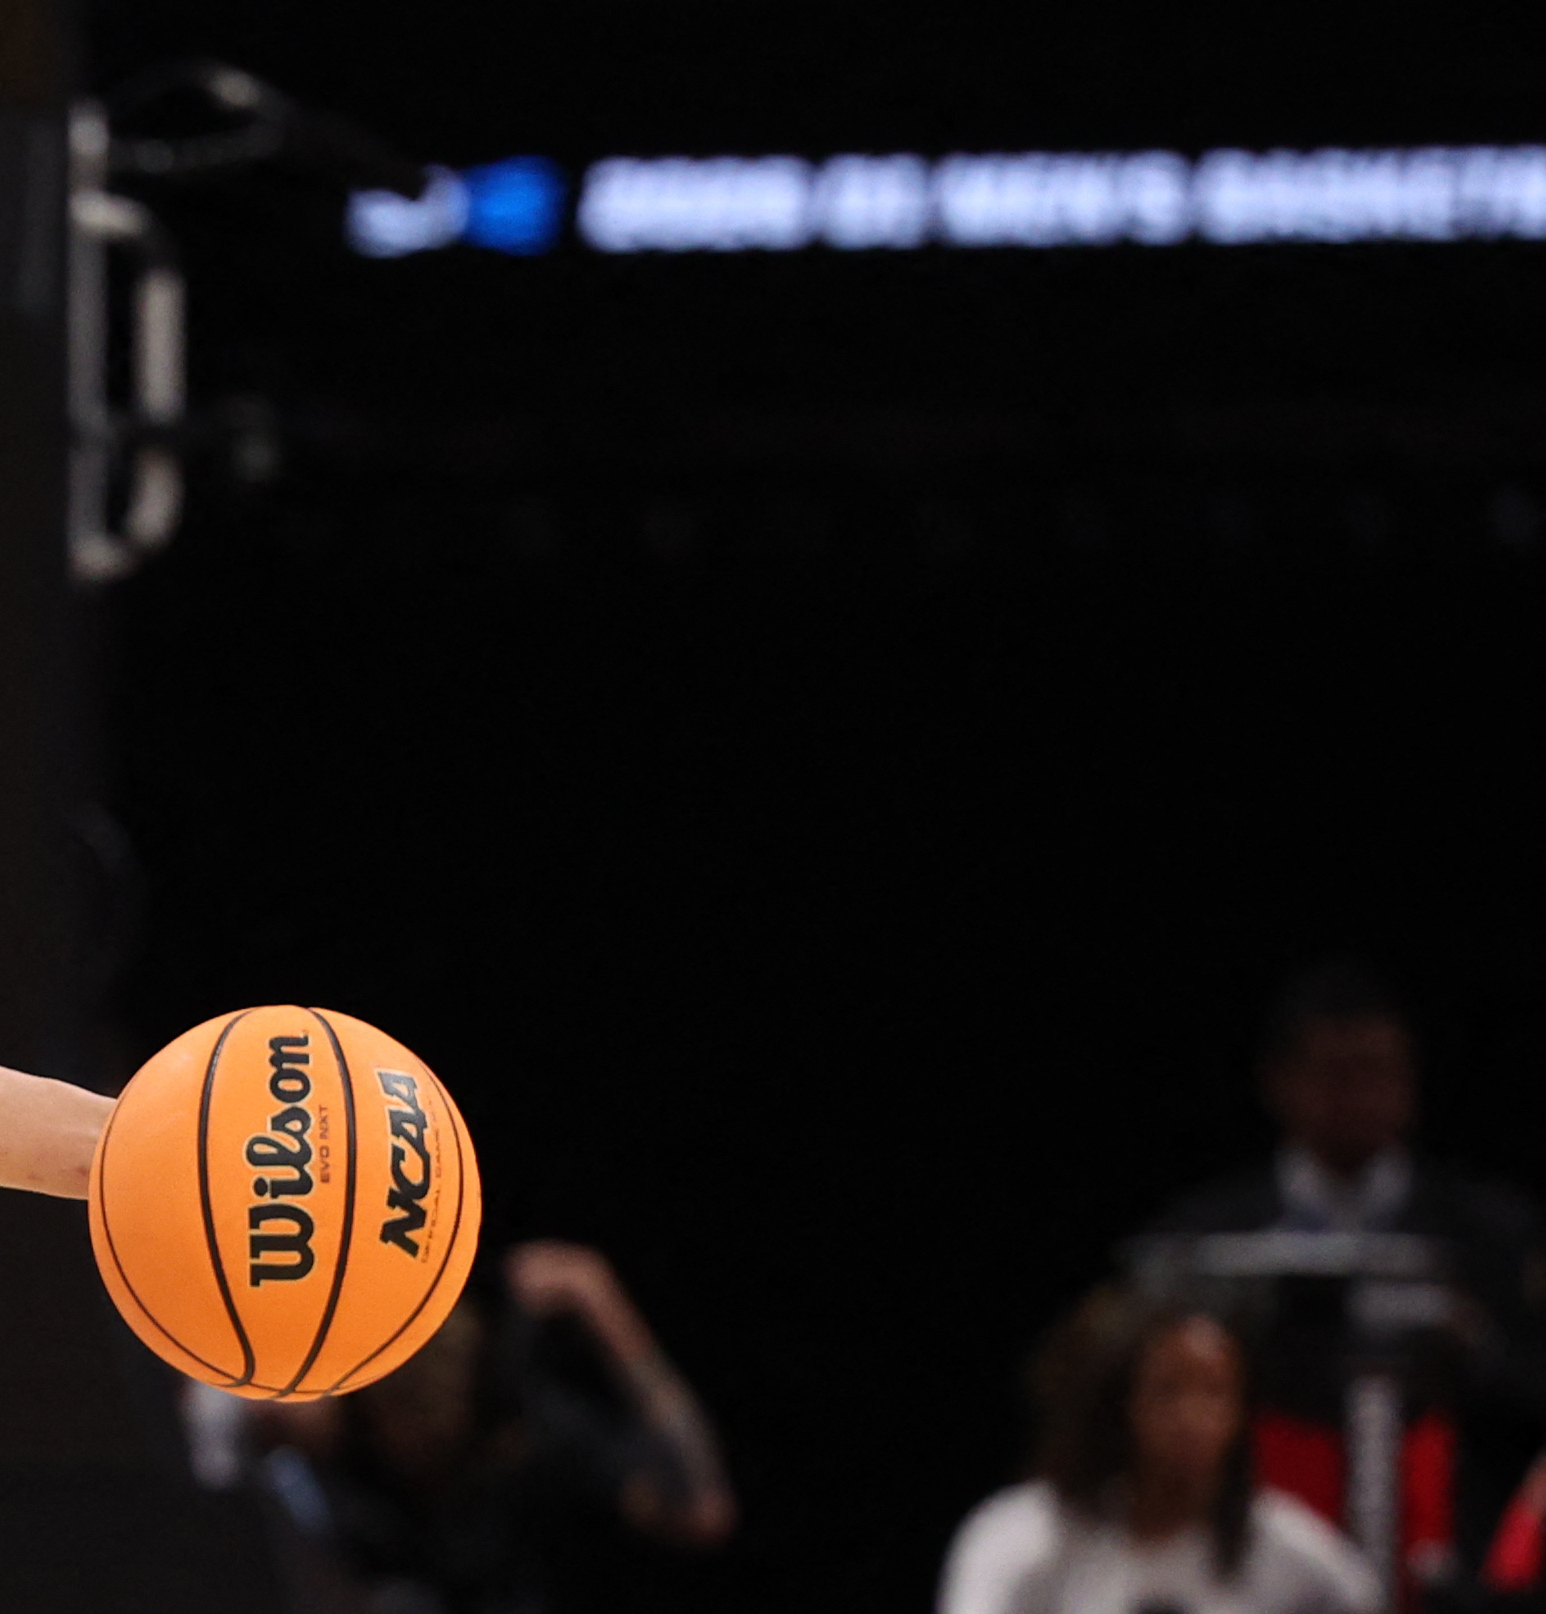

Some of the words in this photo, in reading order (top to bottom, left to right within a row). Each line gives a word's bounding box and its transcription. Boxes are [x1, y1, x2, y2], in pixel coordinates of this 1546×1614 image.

[244, 1033, 316, 1289] Wilson
[317, 1103, 330, 1141] NXT
[318, 1145, 331, 1184] EVO
[375, 1068, 431, 1259] NCAA
